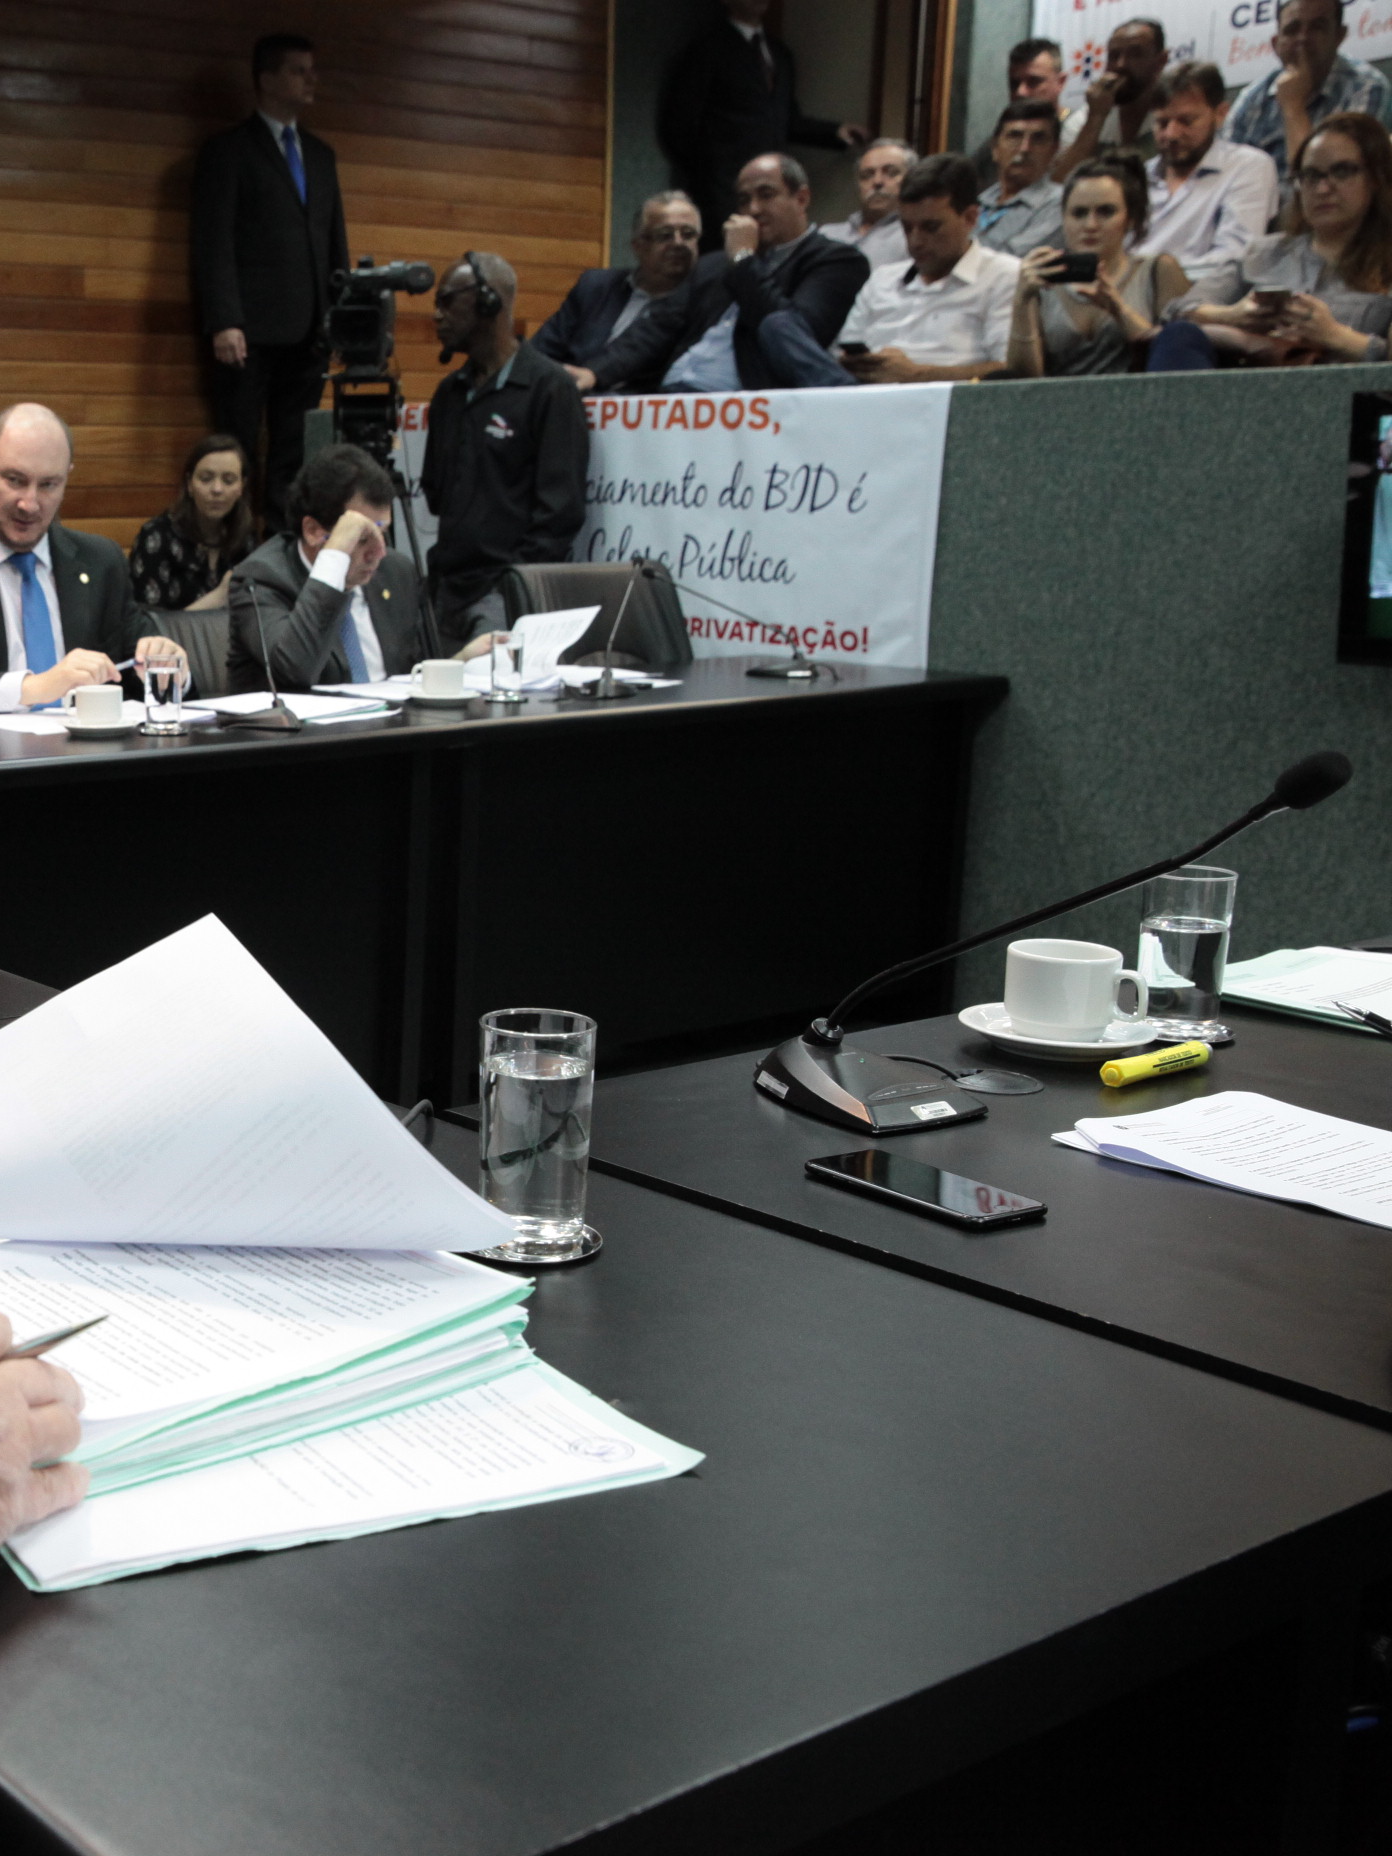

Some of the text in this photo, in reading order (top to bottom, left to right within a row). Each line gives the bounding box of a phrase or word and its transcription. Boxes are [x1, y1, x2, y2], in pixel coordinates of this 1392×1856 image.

[583, 396, 781, 435] EPUTADOS,
[585, 460, 708, 510] ciamento
[718, 460, 755, 510] do
[847, 471, 868, 514] é
[678, 528, 796, 585] Pública
[682, 616, 869, 654] RIVATIZAÇÃO!
